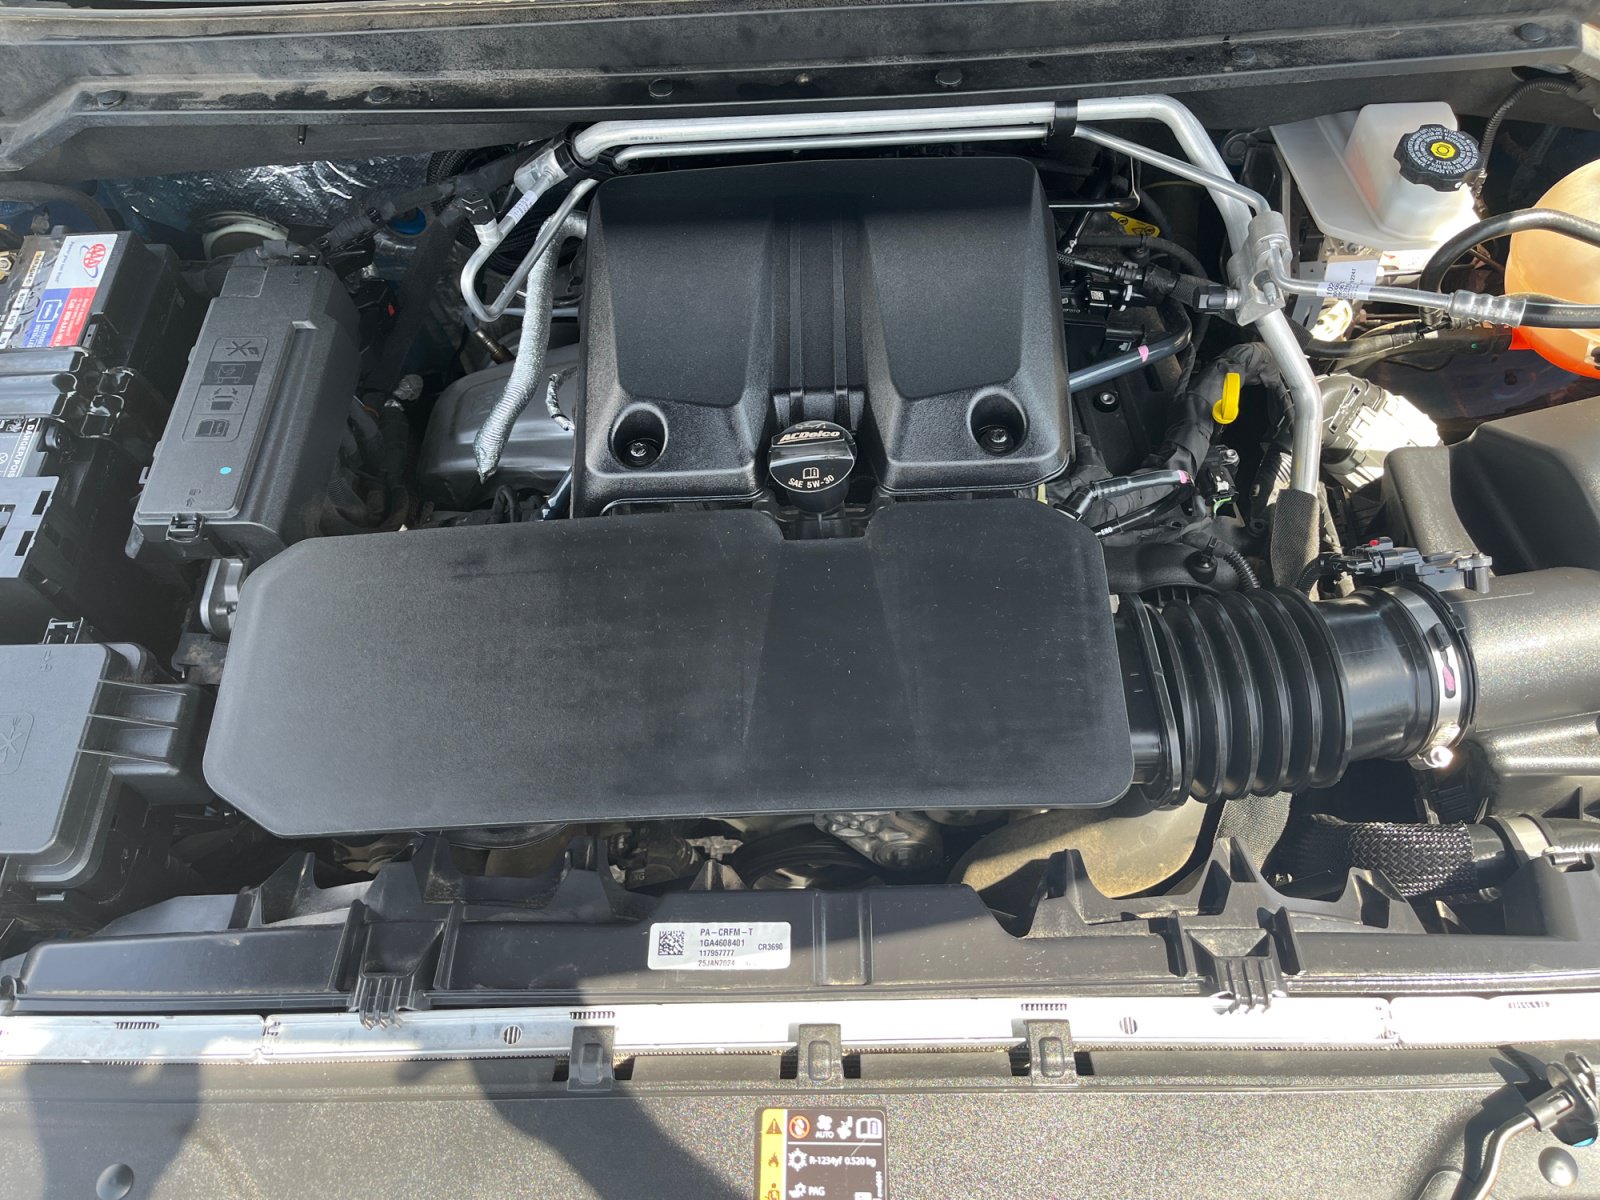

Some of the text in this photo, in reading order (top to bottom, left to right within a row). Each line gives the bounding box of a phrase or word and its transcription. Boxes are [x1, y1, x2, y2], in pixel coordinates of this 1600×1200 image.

[779, 430, 840, 442] ACDelco
[788, 474, 835, 489] SAE 5W-30
[700, 939, 745, 947] 1GA4608401
[758, 943, 783, 951] CR3690
[815, 1131, 835, 1139] AUTO
[844, 1156, 866, 1166] 0.520
[866, 1156, 877, 1167] kg
[808, 1186, 826, 1196] PAG
